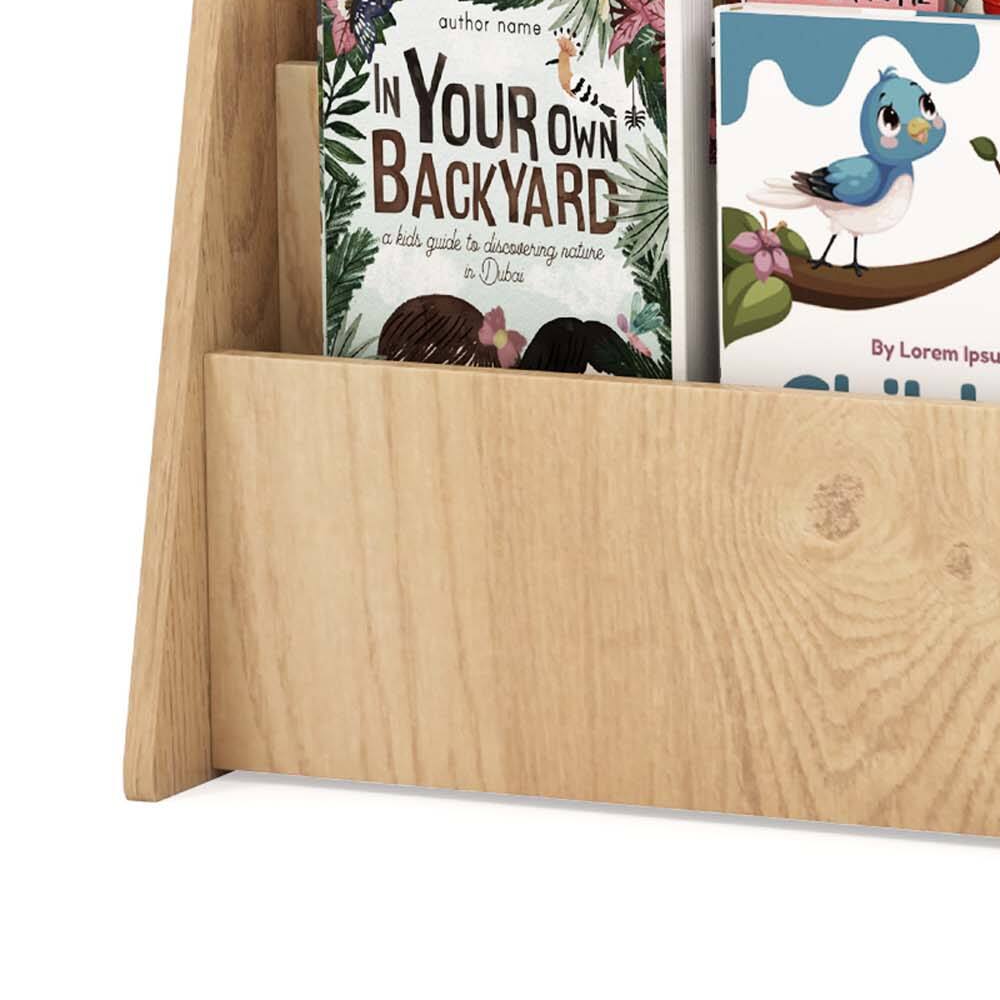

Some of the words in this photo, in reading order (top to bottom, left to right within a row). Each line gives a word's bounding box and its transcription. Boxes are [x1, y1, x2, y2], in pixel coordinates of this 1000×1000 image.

[438, 11, 490, 33] author
[497, 18, 542, 36] name
[403, 47, 539, 162] YOUR
[547, 103, 619, 163] OWN
[371, 128, 620, 235] BACKYARD
[382, 231, 393, 246] a
[395, 224, 422, 248] kids
[426, 228, 462, 258] guide
[465, 232, 480, 252] to
[483, 232, 558, 266] discovering
[560, 244, 605, 261] nature
[463, 264, 476, 280] in
[479, 256, 526, 286] Dubai
[871, 338, 895, 361] By
[900, 341, 959, 362] Lorem
